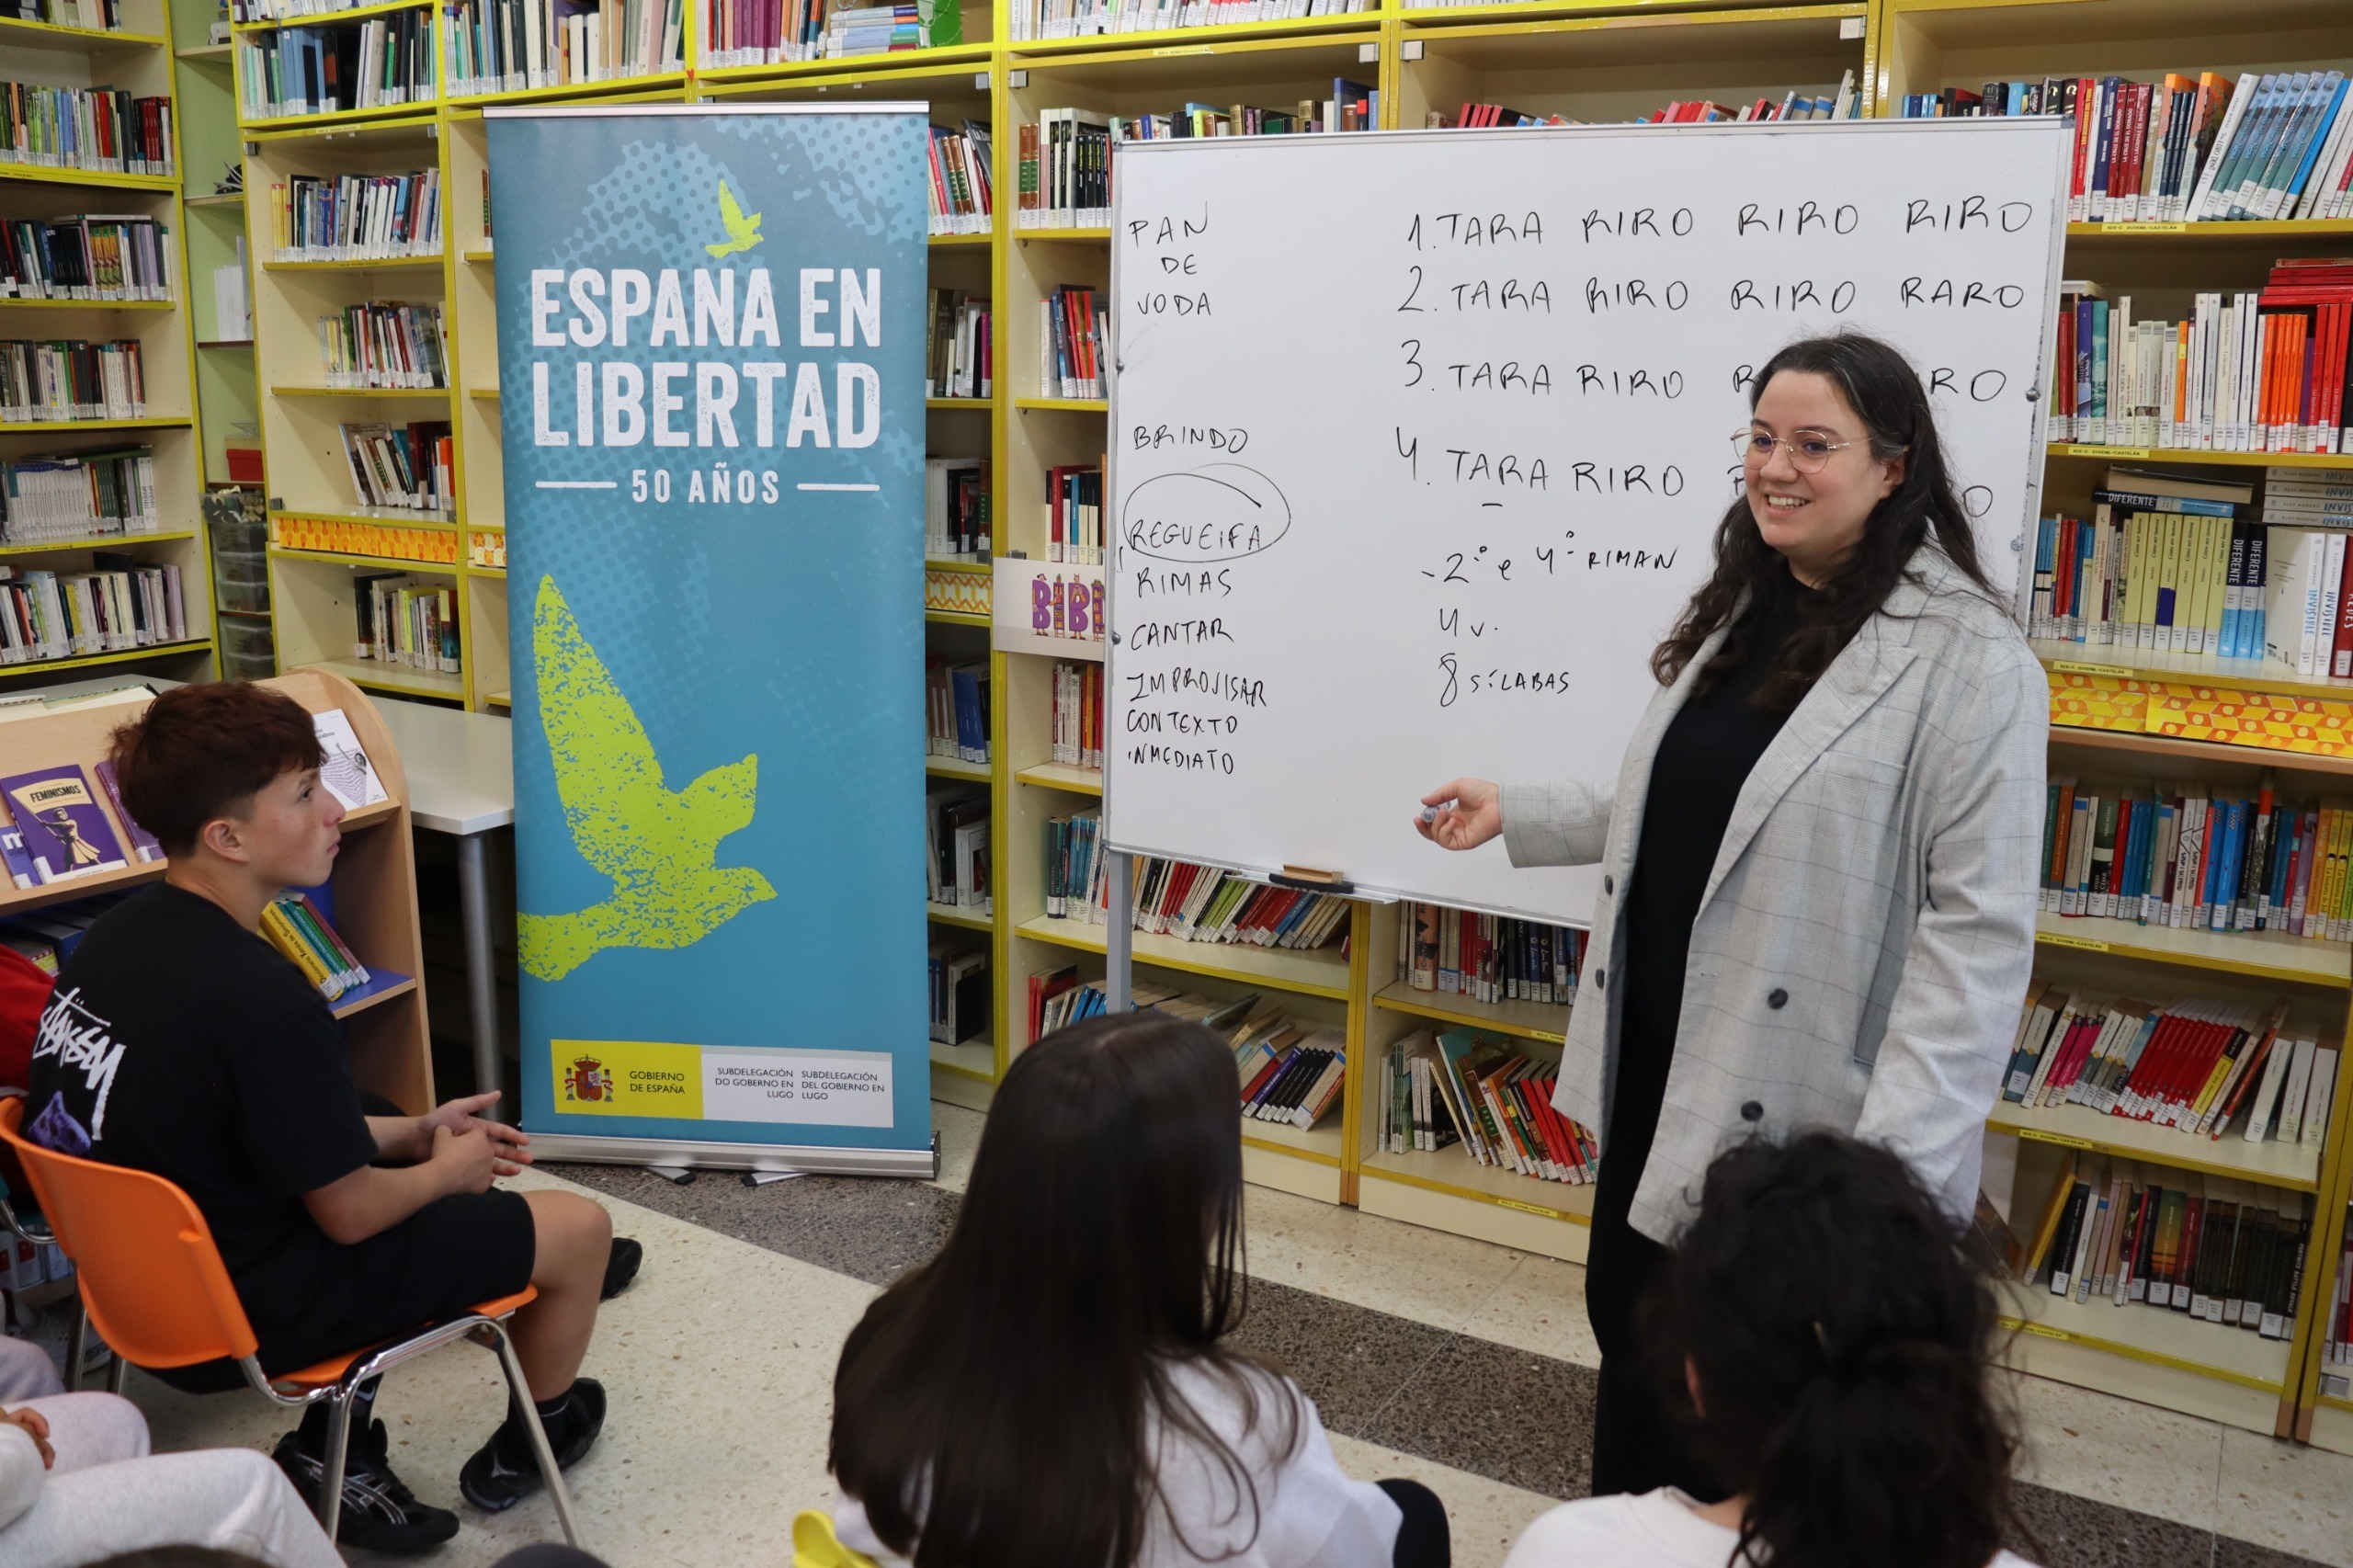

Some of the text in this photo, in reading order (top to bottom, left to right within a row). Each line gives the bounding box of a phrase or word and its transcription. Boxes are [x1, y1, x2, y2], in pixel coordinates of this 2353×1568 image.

[1129, 201, 1208, 248] PAN
[1437, 211, 1543, 245] TARA
[1582, 208, 1693, 244] RIRO
[1738, 201, 1859, 236] RIRO
[1905, 195, 2033, 233] RIRO
[1161, 254, 1198, 275] DE
[800, 267, 881, 347] EN
[1450, 279, 1551, 313] TARA
[1586, 277, 1688, 313] RIRO
[1731, 280, 1856, 313] RIRO
[1901, 277, 2024, 309] RARO
[1449, 362, 1552, 395] TARA
[1576, 364, 1683, 399] RIRO
[533, 361, 881, 449] LIBERTAD
[1134, 425, 1248, 453] BRINDO
[632, 462, 779, 505] 50 AÑOS
[1447, 449, 1549, 491] TARA
[1572, 461, 1684, 496] RIRO
[2109, 493, 2154, 506] DIFERENTE
[1589, 546, 1679, 570] RIMAN
[2229, 540, 2244, 584] DIFERENTE
[2247, 540, 2262, 585] DIFERENTE
[1138, 567, 1232, 597] RIMAS
[2304, 588, 2319, 636] INVISIBLE
[2322, 591, 2336, 636] INVISIBLE
[1131, 619, 1234, 651] CANTAR
[1127, 667, 1267, 707] IMPROVISAR
[1438, 653, 1458, 707] 8
[1127, 710, 1237, 736] CONTEXTO
[29, 785, 82, 803] FEMINISMOS
[630, 1071, 685, 1082] GOBIERNO
[715, 1077, 794, 1088] DO GOBERNO EN
[718, 1067, 793, 1078] SUBDELEGACIÓN
[801, 1070, 878, 1082] SUBDELEGACIÓN
[801, 1080, 885, 1094] DEL GOBIERNO EN
[630, 1082, 686, 1095] DE ESPAÑA
[767, 1089, 793, 1099] LUGO
[801, 1091, 828, 1101] LUGO
